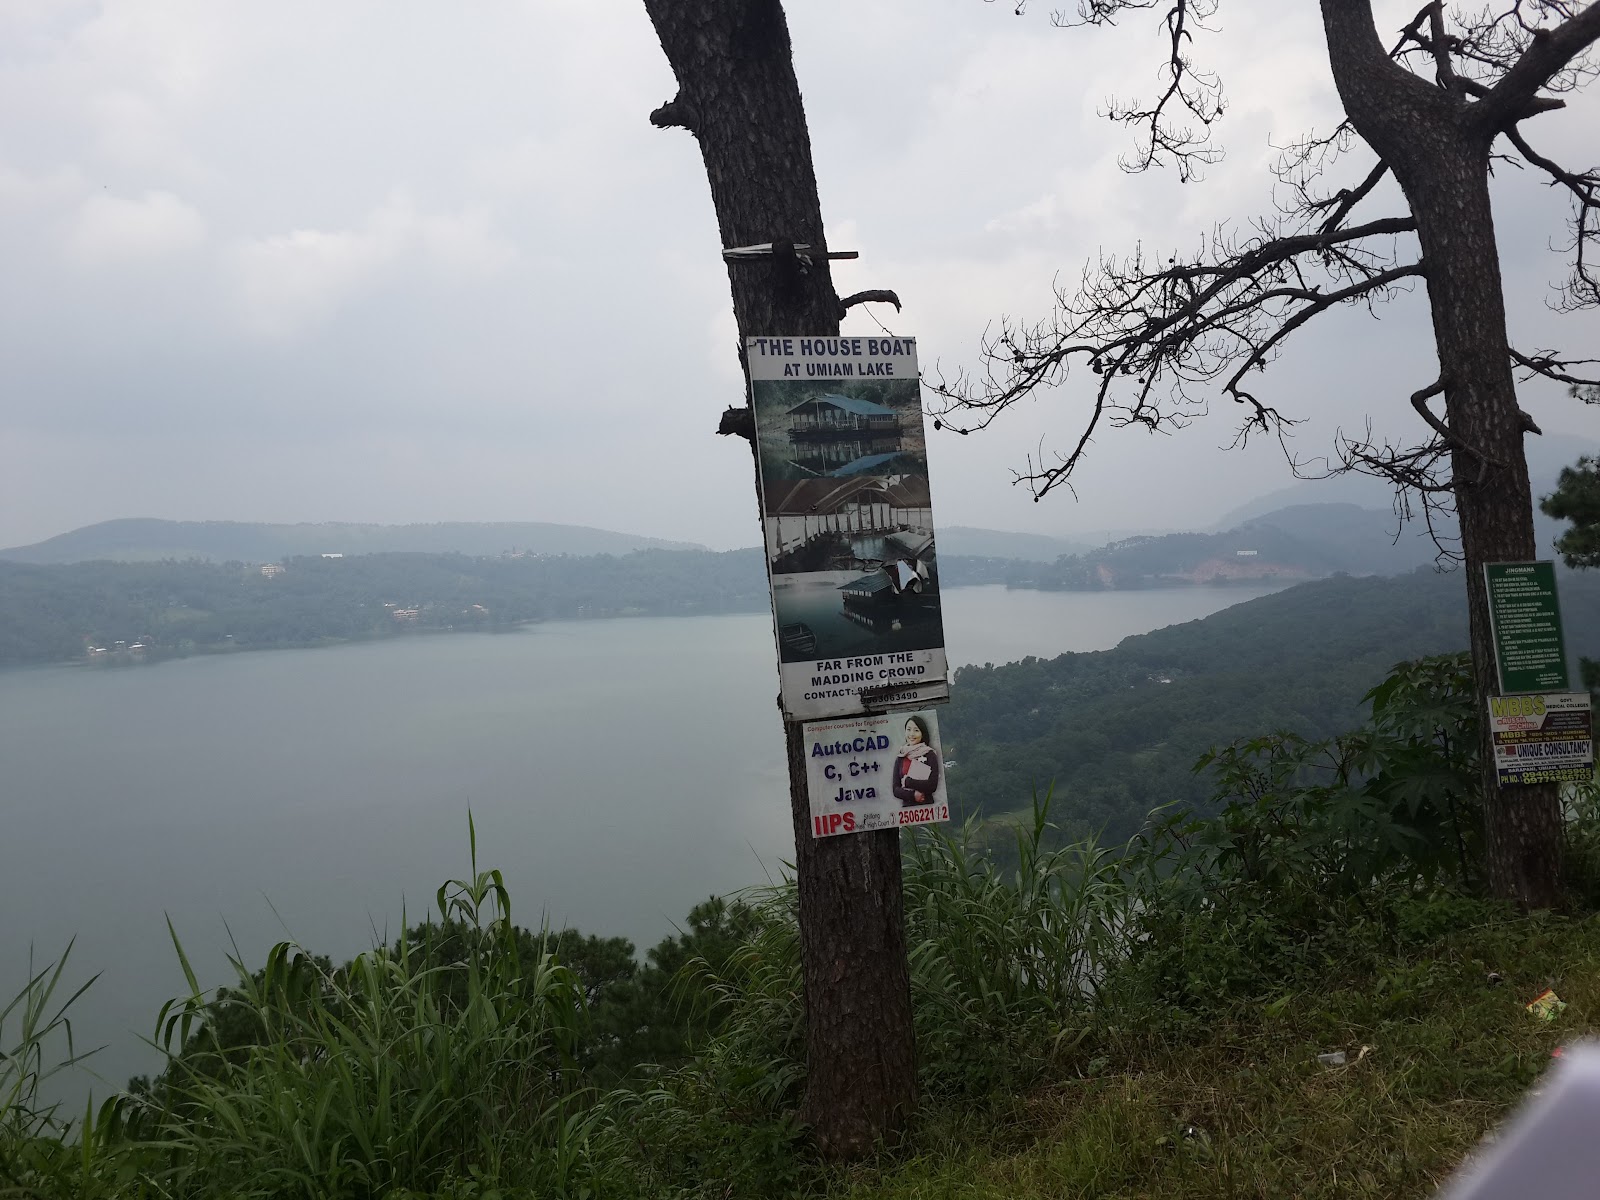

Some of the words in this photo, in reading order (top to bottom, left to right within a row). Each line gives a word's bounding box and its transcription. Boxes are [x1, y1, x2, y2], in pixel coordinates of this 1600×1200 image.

[756, 339, 794, 356] THE
[800, 338, 862, 356] HOUSE
[868, 339, 913, 356] BOAT
[783, 363, 801, 377] AT
[806, 363, 853, 377] UMIAM
[858, 362, 894, 376] LAKE
[816, 660, 842, 672] FAR
[846, 656, 884, 669] FROM
[888, 652, 914, 664] THE
[811, 670, 874, 687] MADDING
[879, 665, 925, 678] CROWD
[804, 688, 854, 701] CONTACT:
[1491, 695, 1547, 717] MBBS
[807, 725, 833, 733] Computer
[833, 722, 855, 730] courses
[863, 719, 889, 728] Engineers
[1502, 717, 1527, 725] RUSSIA
[1517, 721, 1538, 729] CHINA
[1500, 731, 1527, 739] MBBS
[811, 735, 890, 758] AutoCAD
[1517, 743, 1543, 758] UNIQUE
[1544, 741, 1591, 756] CONSULTANCY
[824, 764, 842, 781] C,
[848, 761, 881, 777] C++
[1501, 775, 1510, 784] PH
[834, 786, 876, 803] Java
[814, 811, 855, 836] IIPS
[898, 808, 935, 824] 2506221
[867, 821, 878, 829] High
